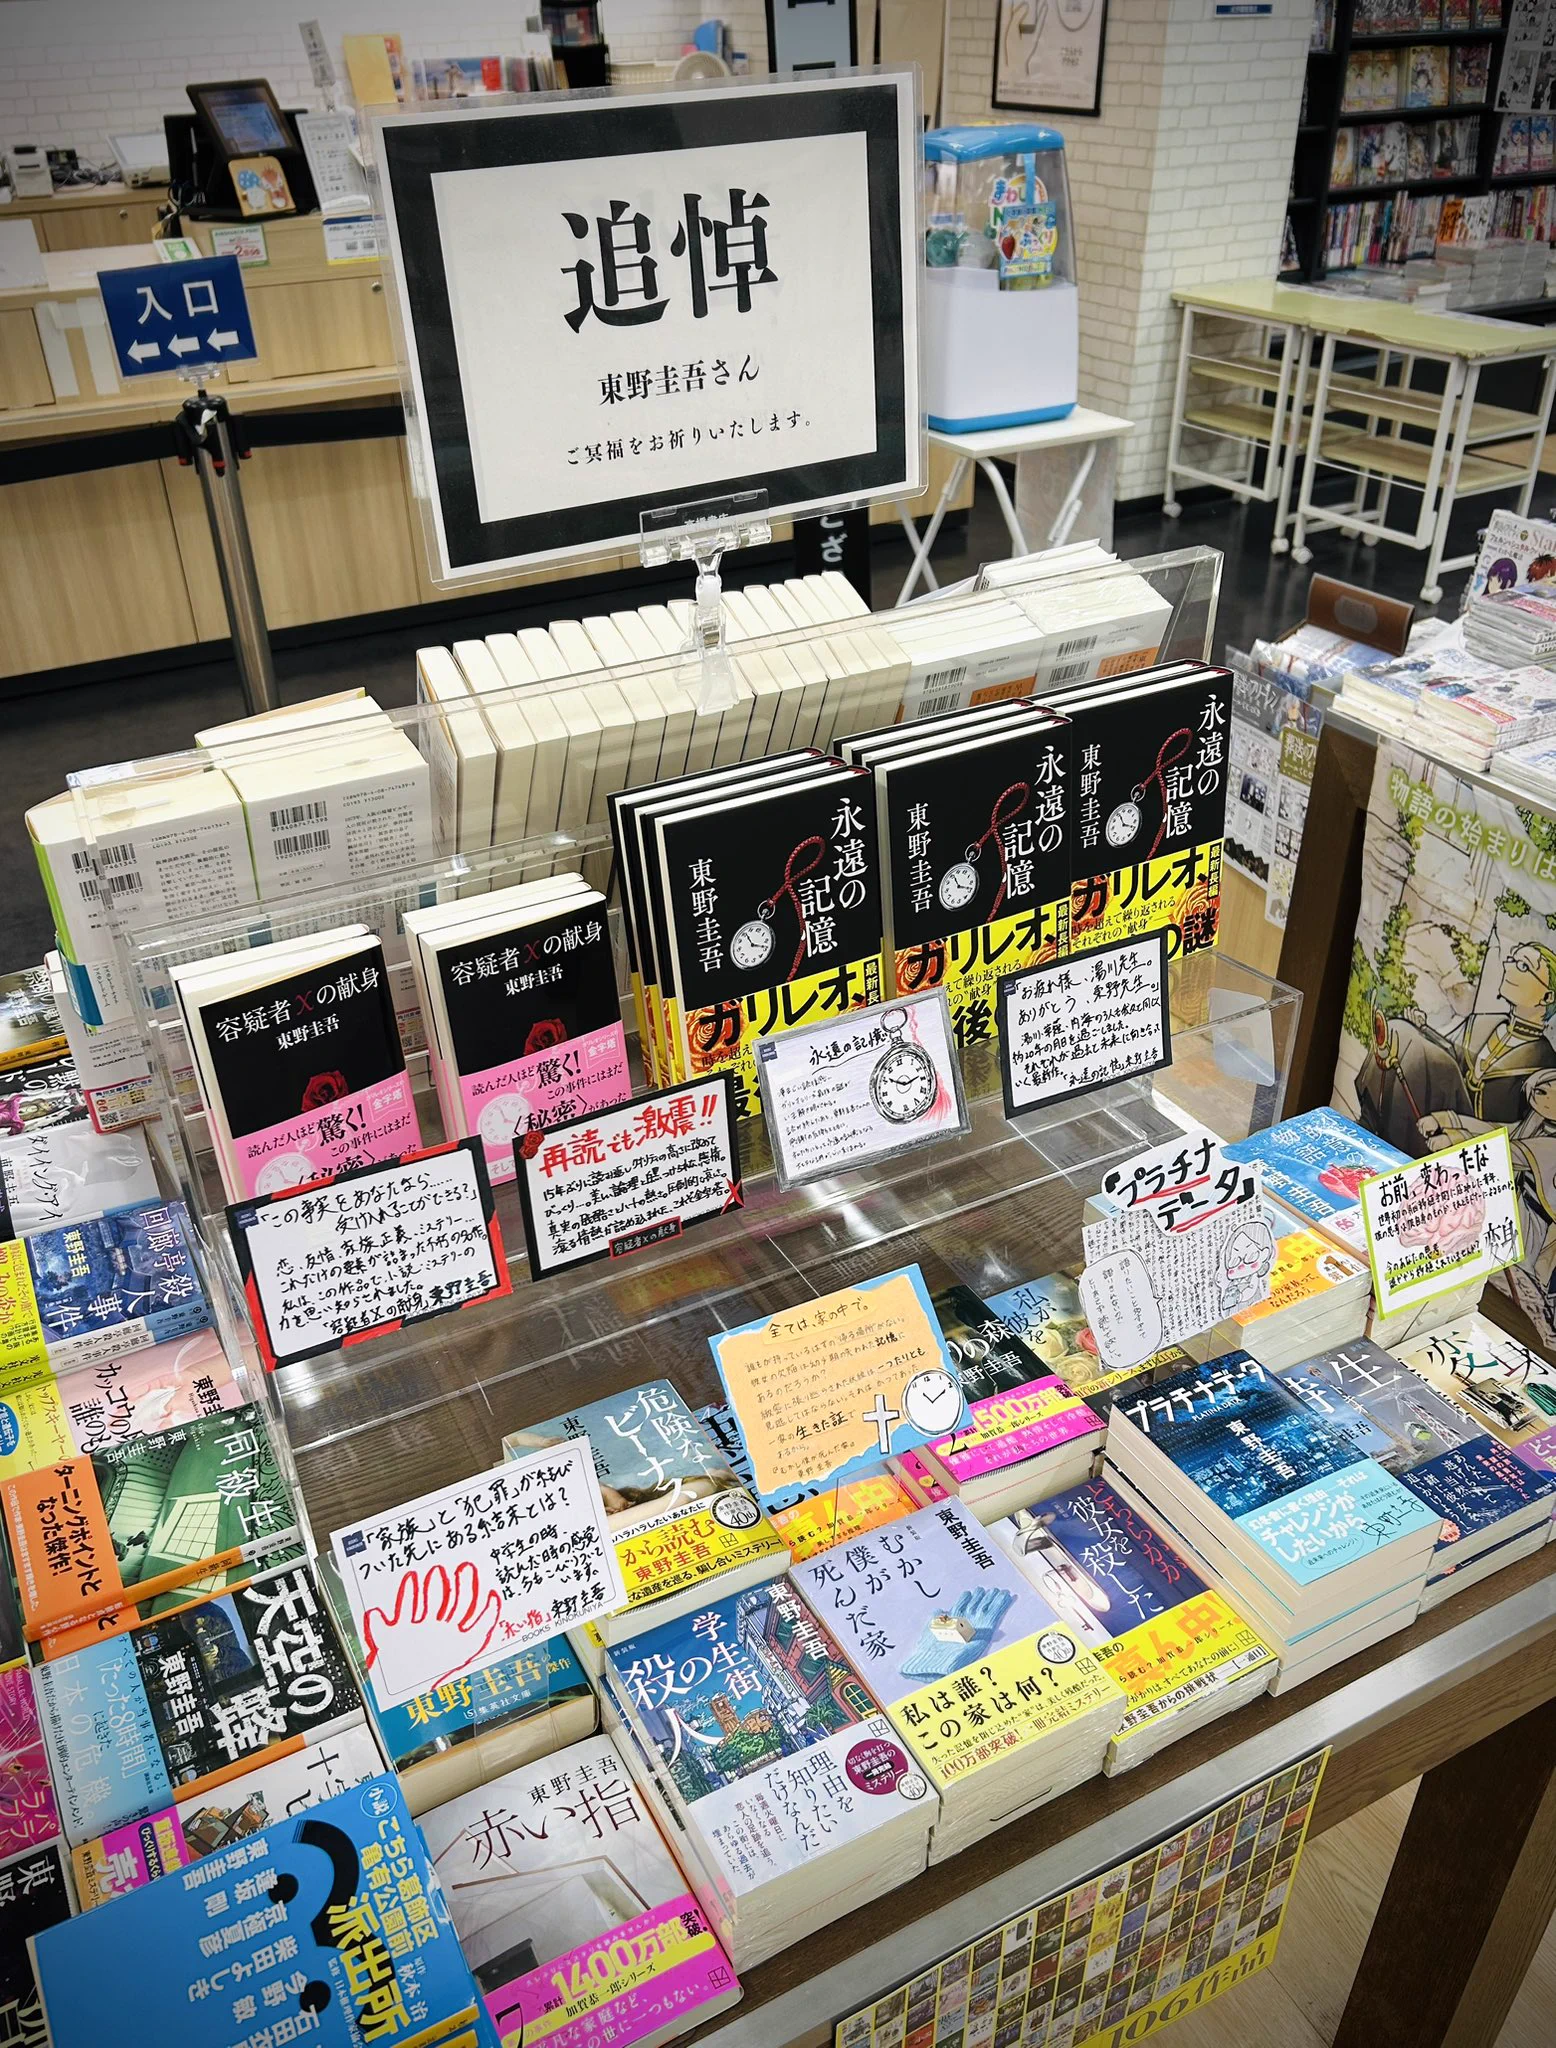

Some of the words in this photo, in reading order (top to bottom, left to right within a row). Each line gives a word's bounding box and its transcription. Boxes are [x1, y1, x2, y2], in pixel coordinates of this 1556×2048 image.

[560, 188, 780, 335] 追悼
[137, 279, 220, 325] 入口
[598, 354, 761, 407] 東野圭吾さん
[566, 411, 813, 466] ご冥福をお祈りいたします。
[1197, 693, 1226, 796] 永遠の
[1035, 744, 1067, 853] 永遠の
[1080, 743, 1102, 849] 東野圭吾
[1164, 765, 1194, 840] 記憶
[830, 797, 869, 910] 永遠の
[906, 802, 934, 913] 東野圭吾
[1002, 819, 1036, 900] 記憶
[688, 858, 724, 974] 東野圭吾
[800, 876, 840, 958] 記憶
[504, 964, 564, 998] 東野圭吾
[276, 1014, 340, 1052] 東野圭吾
[546, 1065, 624, 1101] この事件にはまだ
[330, 1112, 412, 1159] この事件にはまだ
[62, 1229, 91, 1278] 東野圭吾
[429, 1270, 493, 1305] 東野圭吾
[1013, 1287, 1057, 1323] 私が
[191, 1375, 225, 1417] 東野圭
[636, 1388, 714, 1464] 危険な
[1126, 1359, 1266, 1433] プラチナデータ
[107, 1428, 186, 1465] 東野圭吾
[603, 1404, 698, 1513] ビーナス
[1225, 1418, 1294, 1482] 東野圭吾
[215, 1428, 282, 1537] 同級生
[54, 1464, 103, 1597] ターニングポイントと
[620, 1518, 716, 1566] から読む
[632, 1542, 712, 1582] 東野圭吾
[936, 1508, 996, 1570] 東野圭吾
[1068, 1493, 1164, 1621] 彼女を殺した
[846, 1545, 892, 1594] 僕が
[881, 1534, 942, 1599] むかし
[551, 1582, 606, 1619] 東野圭吾
[764, 1582, 830, 1659] 東野圭吾
[809, 1560, 896, 1661] 死んだ家
[243, 1566, 335, 1716] 天空の
[691, 1610, 764, 1700] 学生街
[157, 1651, 205, 1738] 東野圭吾
[209, 1685, 288, 1761] 蜂
[478, 1691, 532, 1716] 集英社文庫
[900, 1666, 999, 1728] 私は誰?
[916, 1667, 1060, 1751] この家は何?
[527, 1754, 617, 1807] 東野圭吾
[807, 1750, 854, 1814] 理由を
[853, 1749, 896, 1775] 東野圭吾の
[863, 1768, 904, 1793] ミステリー
[366, 1786, 391, 1817] 小説
[465, 1779, 642, 1870] 赤い指
[764, 1768, 821, 1852] だけなんだ
[786, 1766, 838, 1833] 知りたい
[182, 1836, 270, 1893] 東野圭吾
[378, 1816, 440, 1949] こちら葛飾区
[198, 1900, 289, 1959] 京極夏彦
[360, 1840, 410, 1959] 亀有公園前
[188, 1939, 301, 2004] 柴田よしき
[259, 1969, 306, 2008] 今野
[325, 1895, 413, 2043] 派出所
